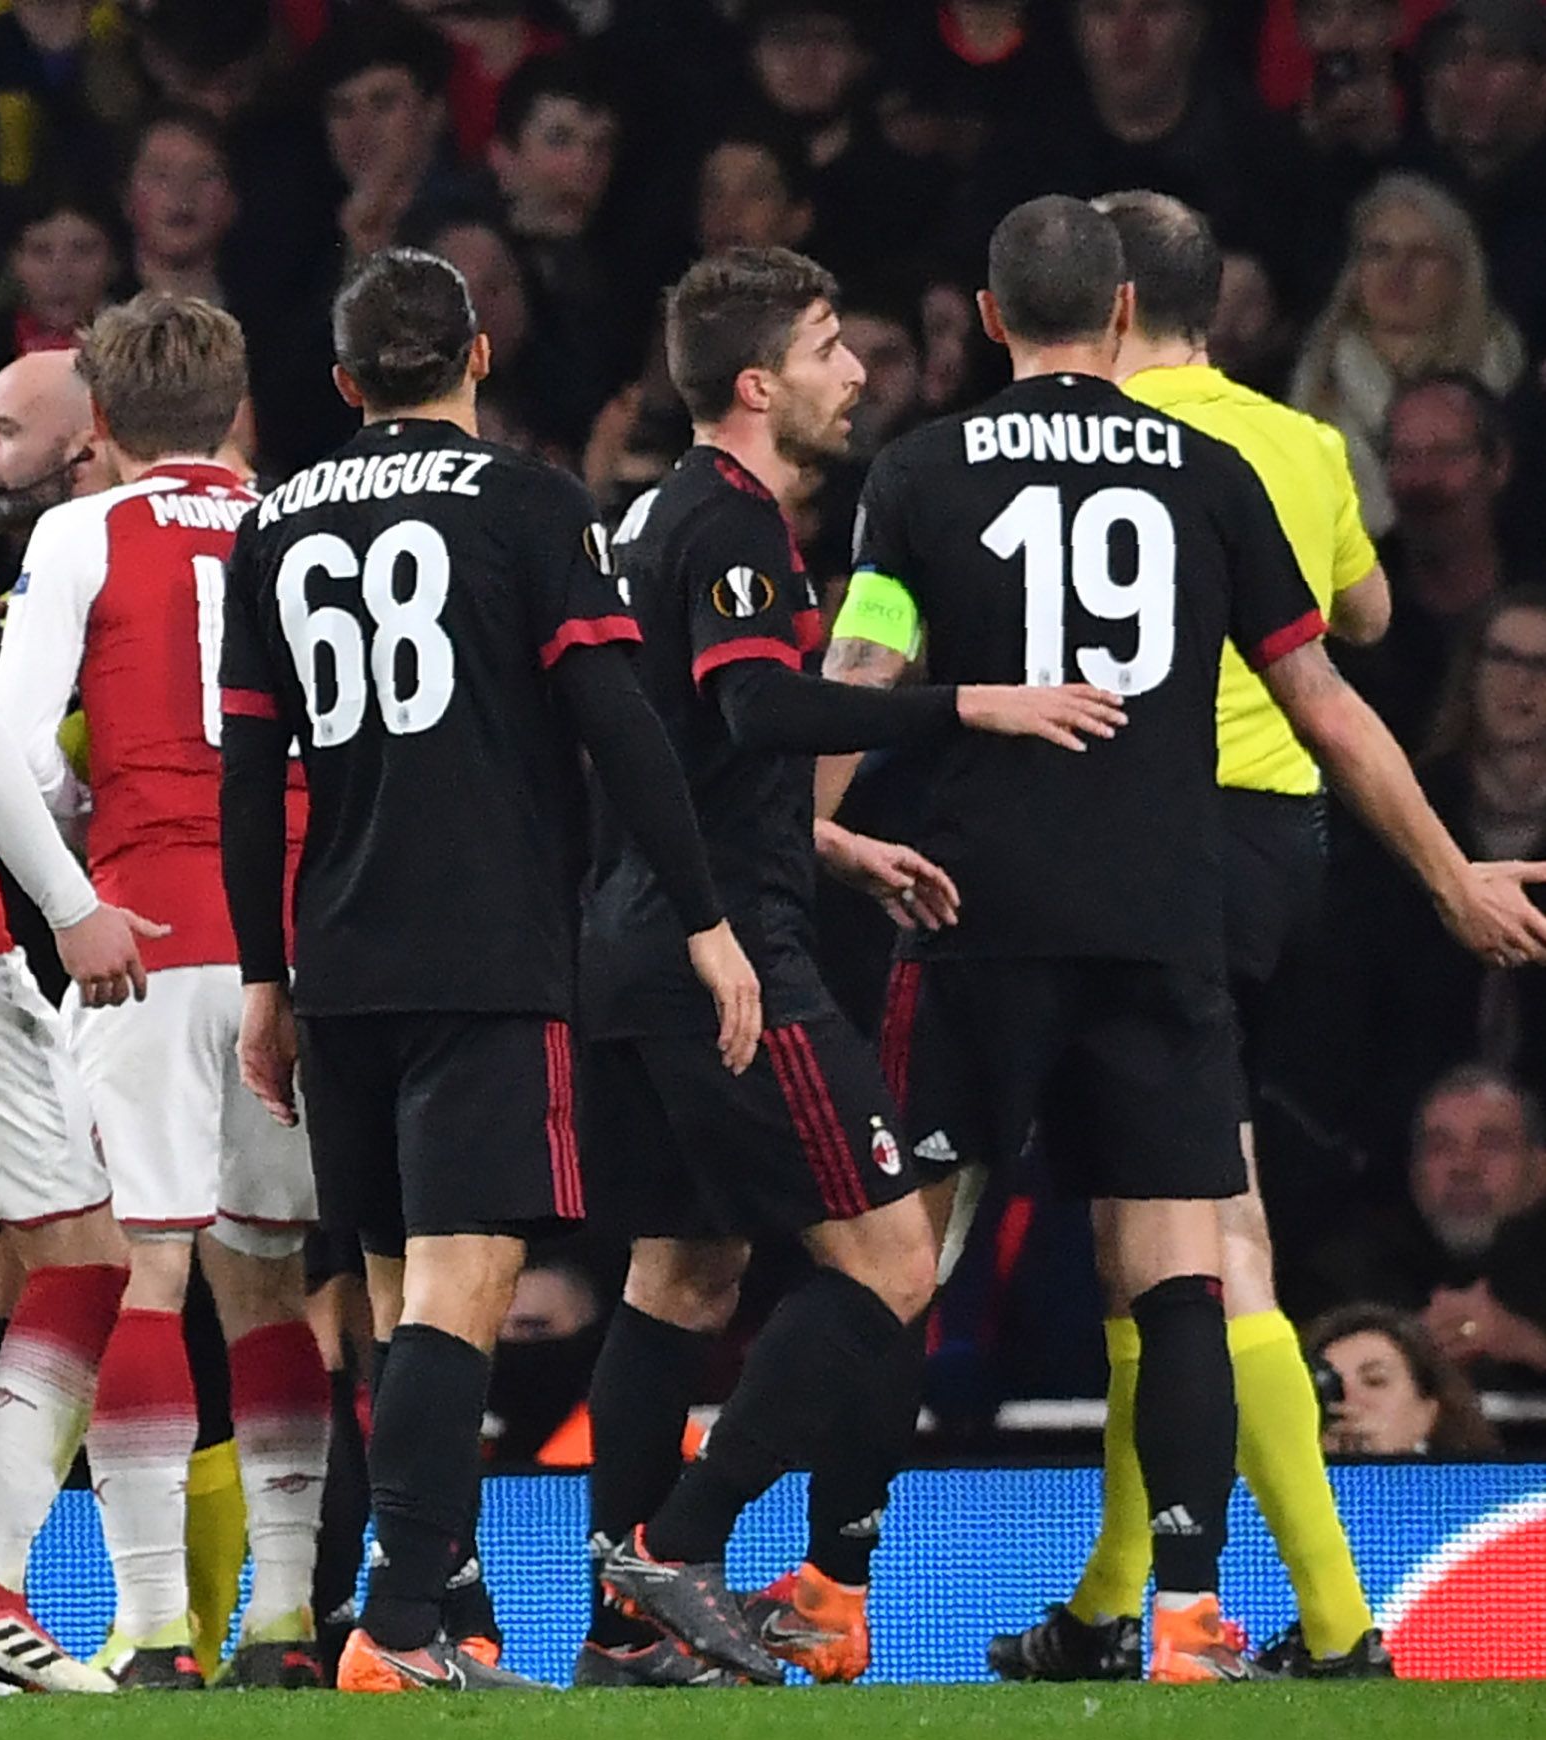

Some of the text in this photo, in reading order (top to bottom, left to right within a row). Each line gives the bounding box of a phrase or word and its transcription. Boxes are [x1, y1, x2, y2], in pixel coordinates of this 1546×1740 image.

[257, 450, 492, 530] RODRIGUEZ
[963, 412, 1182, 469] BONUCCI
[147, 493, 258, 532] MONR
[192, 555, 225, 748] 1
[276, 520, 455, 748] 68
[980, 485, 1177, 695] 19
